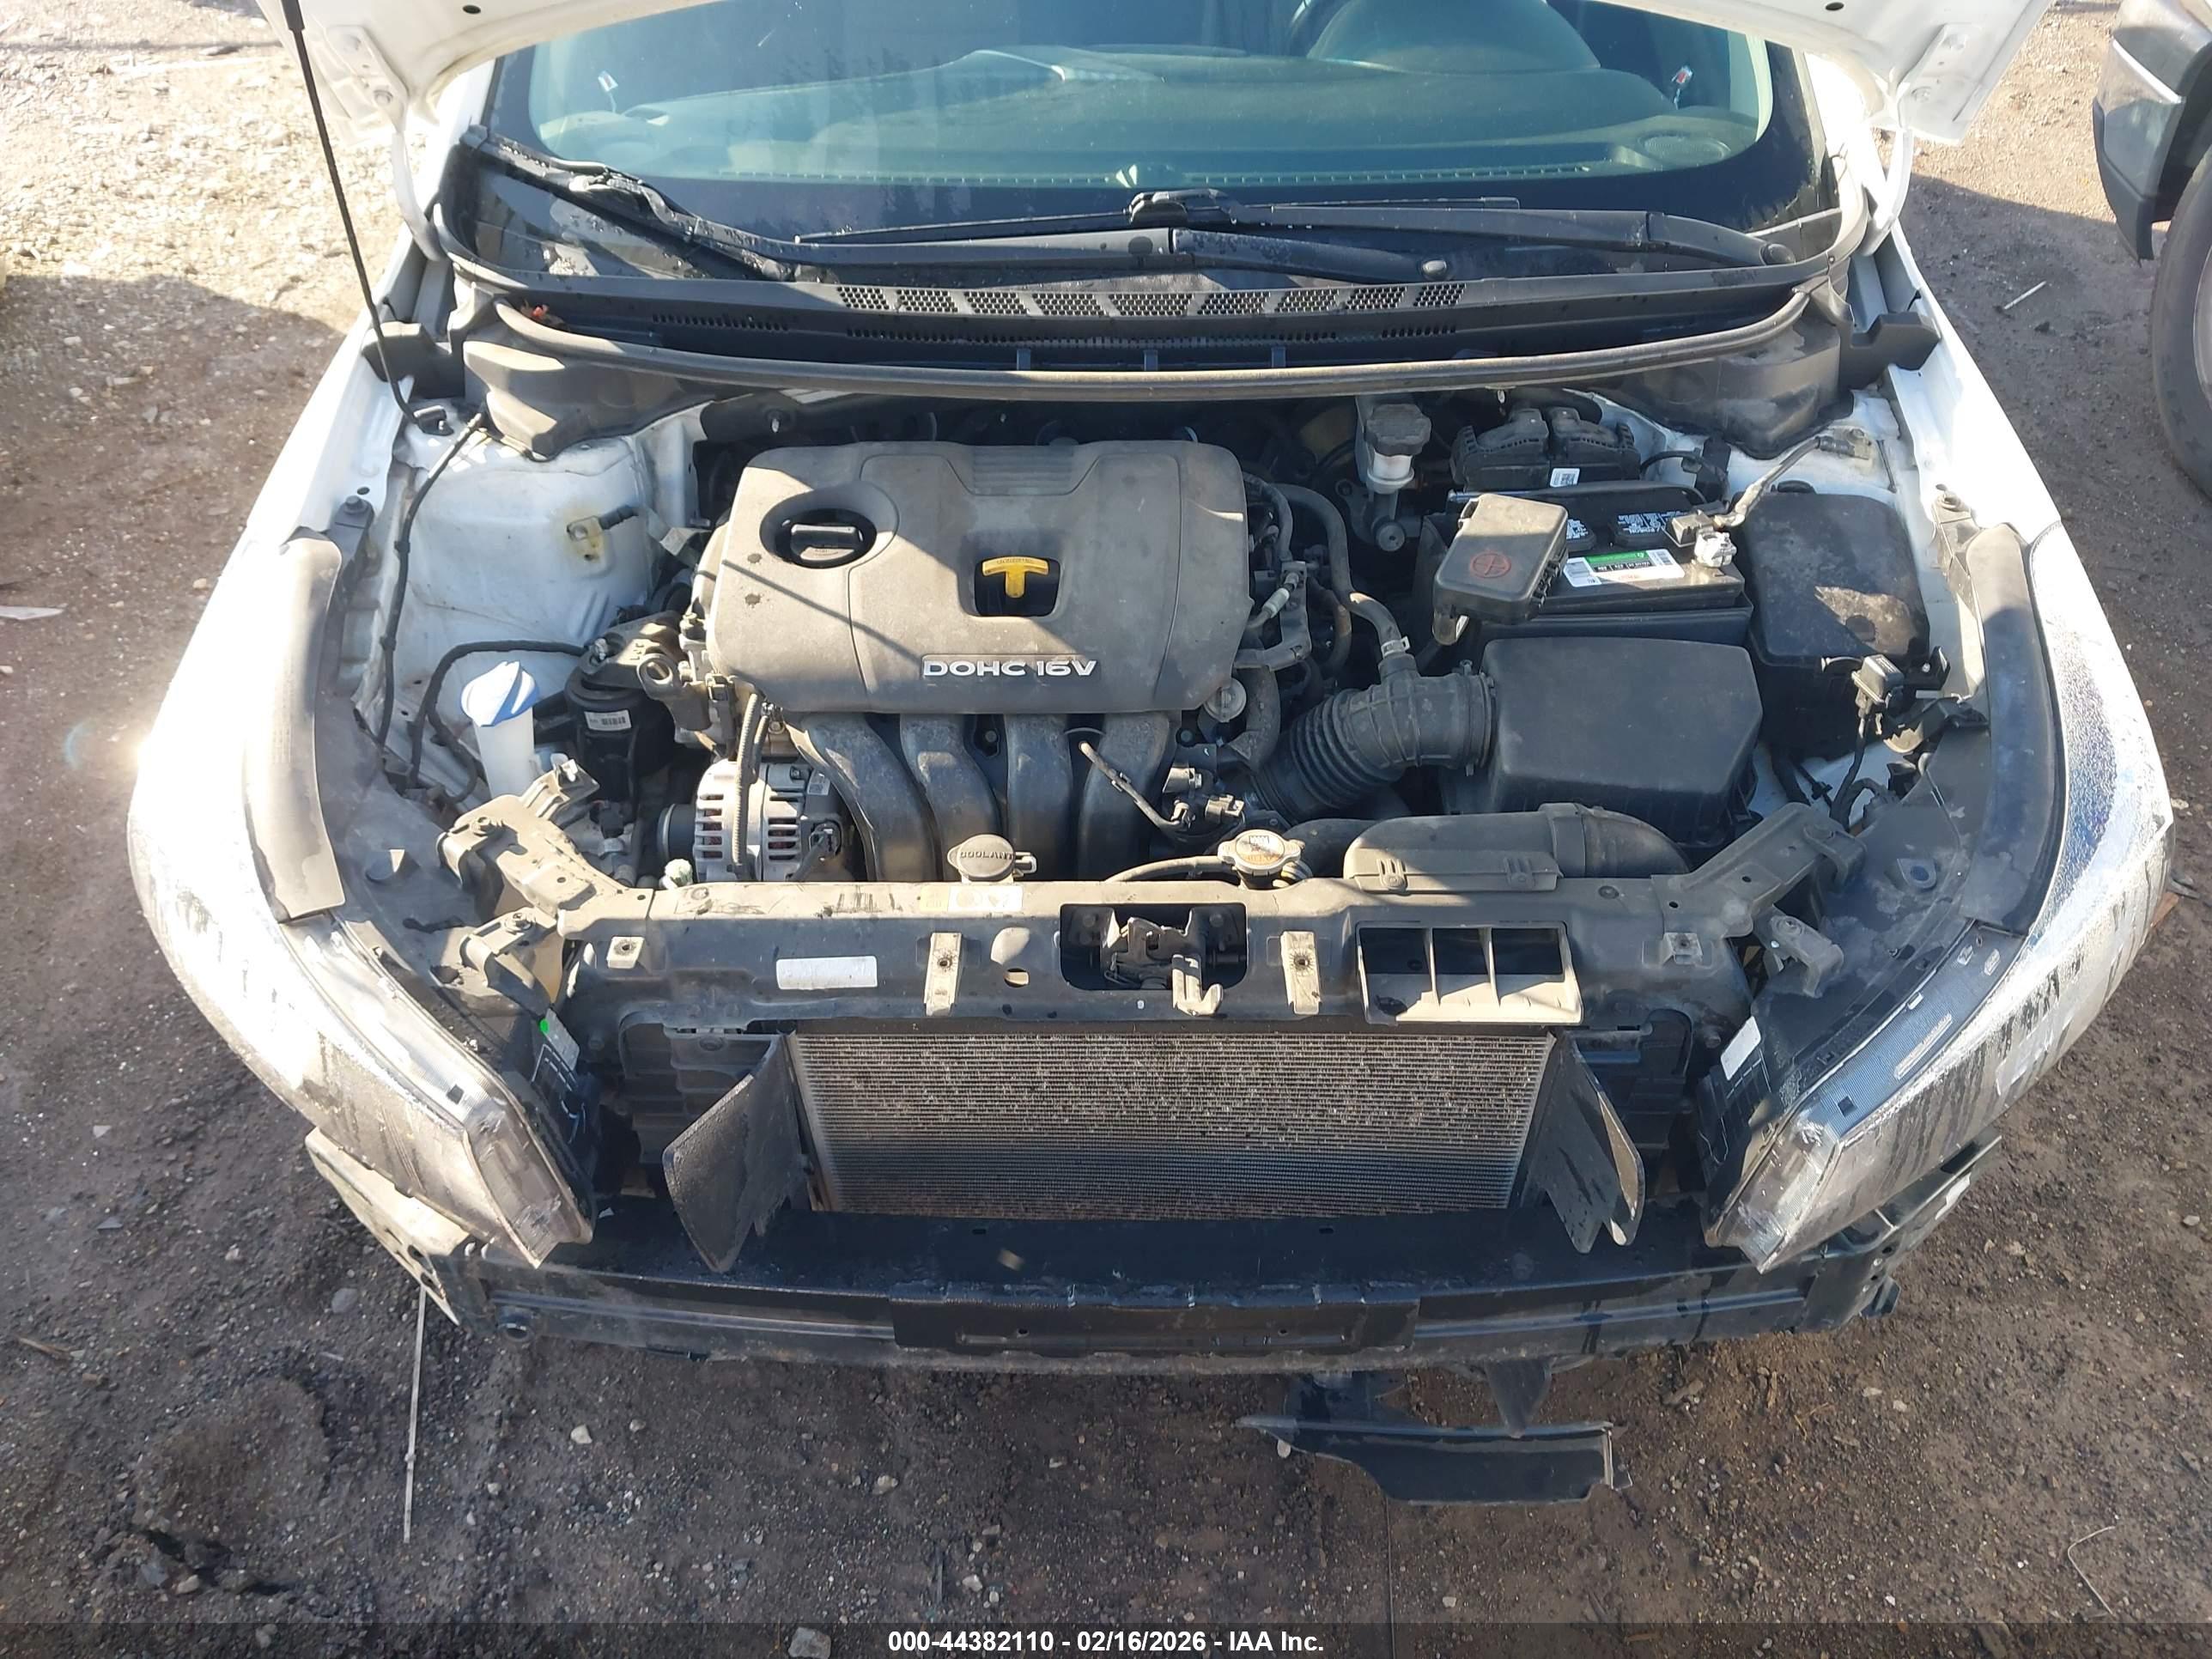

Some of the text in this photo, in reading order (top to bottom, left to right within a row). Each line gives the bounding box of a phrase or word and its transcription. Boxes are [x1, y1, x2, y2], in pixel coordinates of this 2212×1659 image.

[923, 659, 1097, 677] DOHC 16V
[960, 851, 1012, 860] COOLANT
